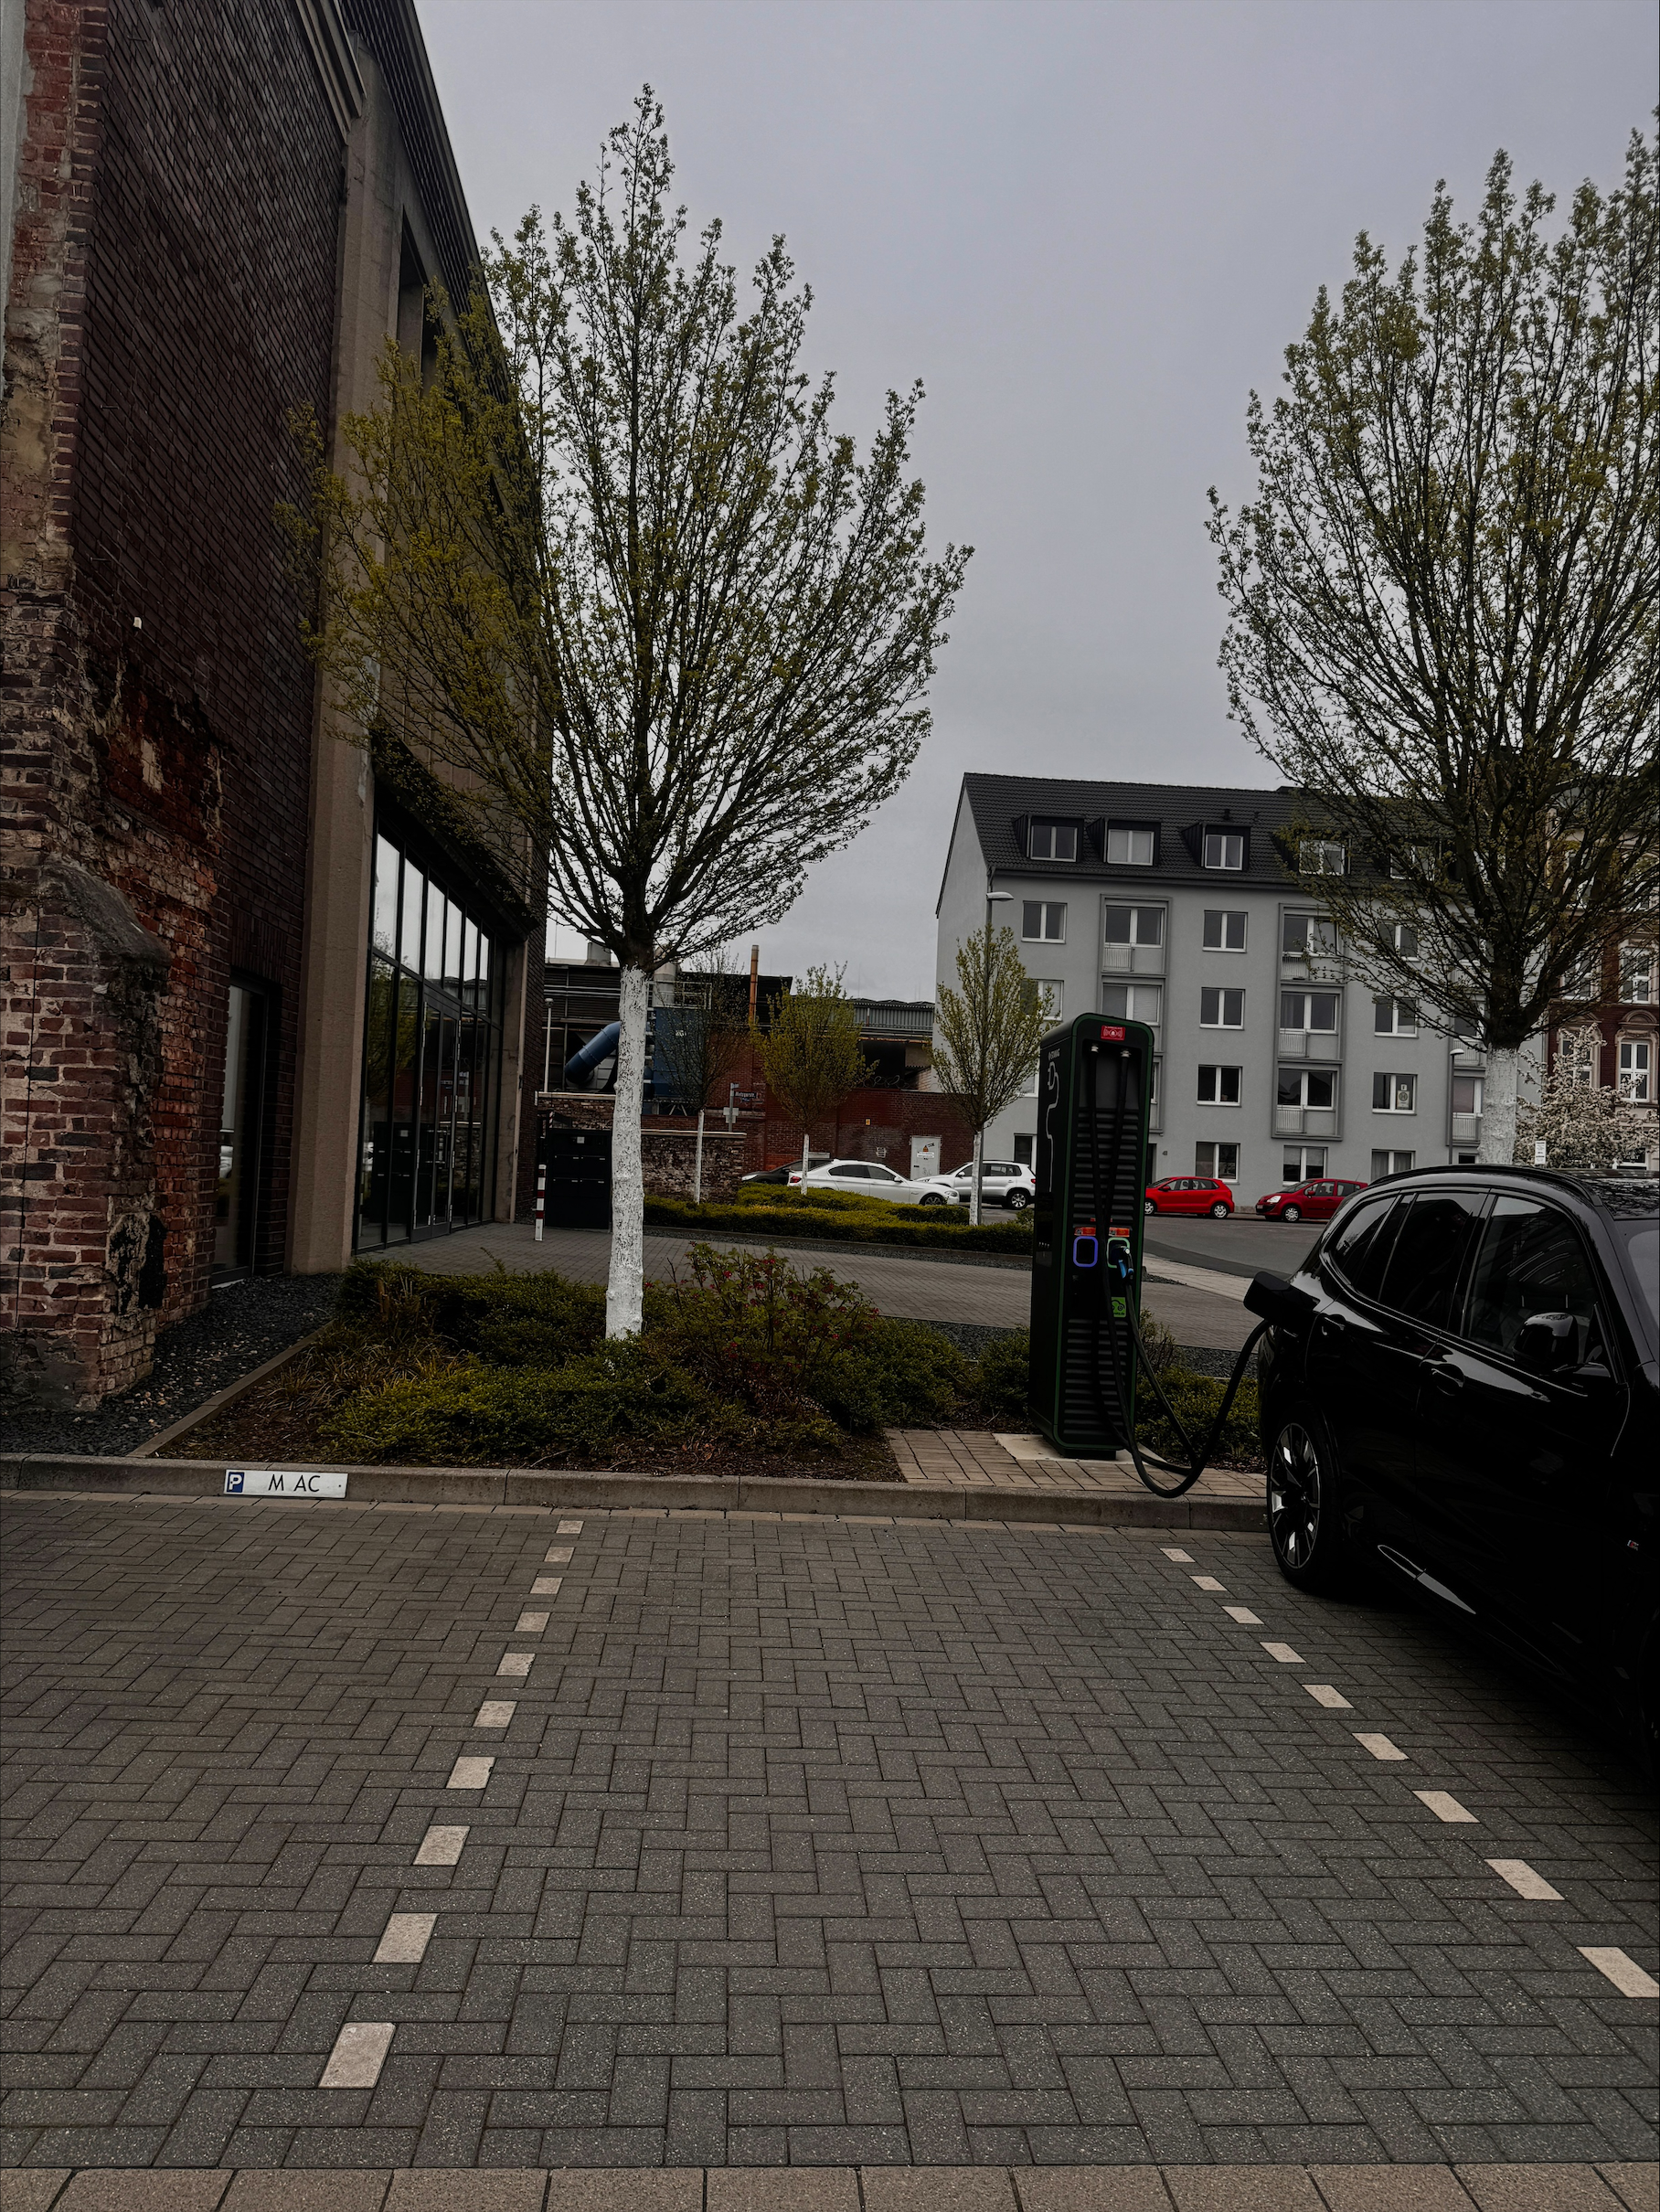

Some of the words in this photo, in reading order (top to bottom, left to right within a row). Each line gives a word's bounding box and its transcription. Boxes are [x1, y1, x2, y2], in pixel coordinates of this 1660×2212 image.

[229, 1473, 243, 1491] P
[268, 1473, 284, 1492] M
[293, 1474, 321, 1493] AC
